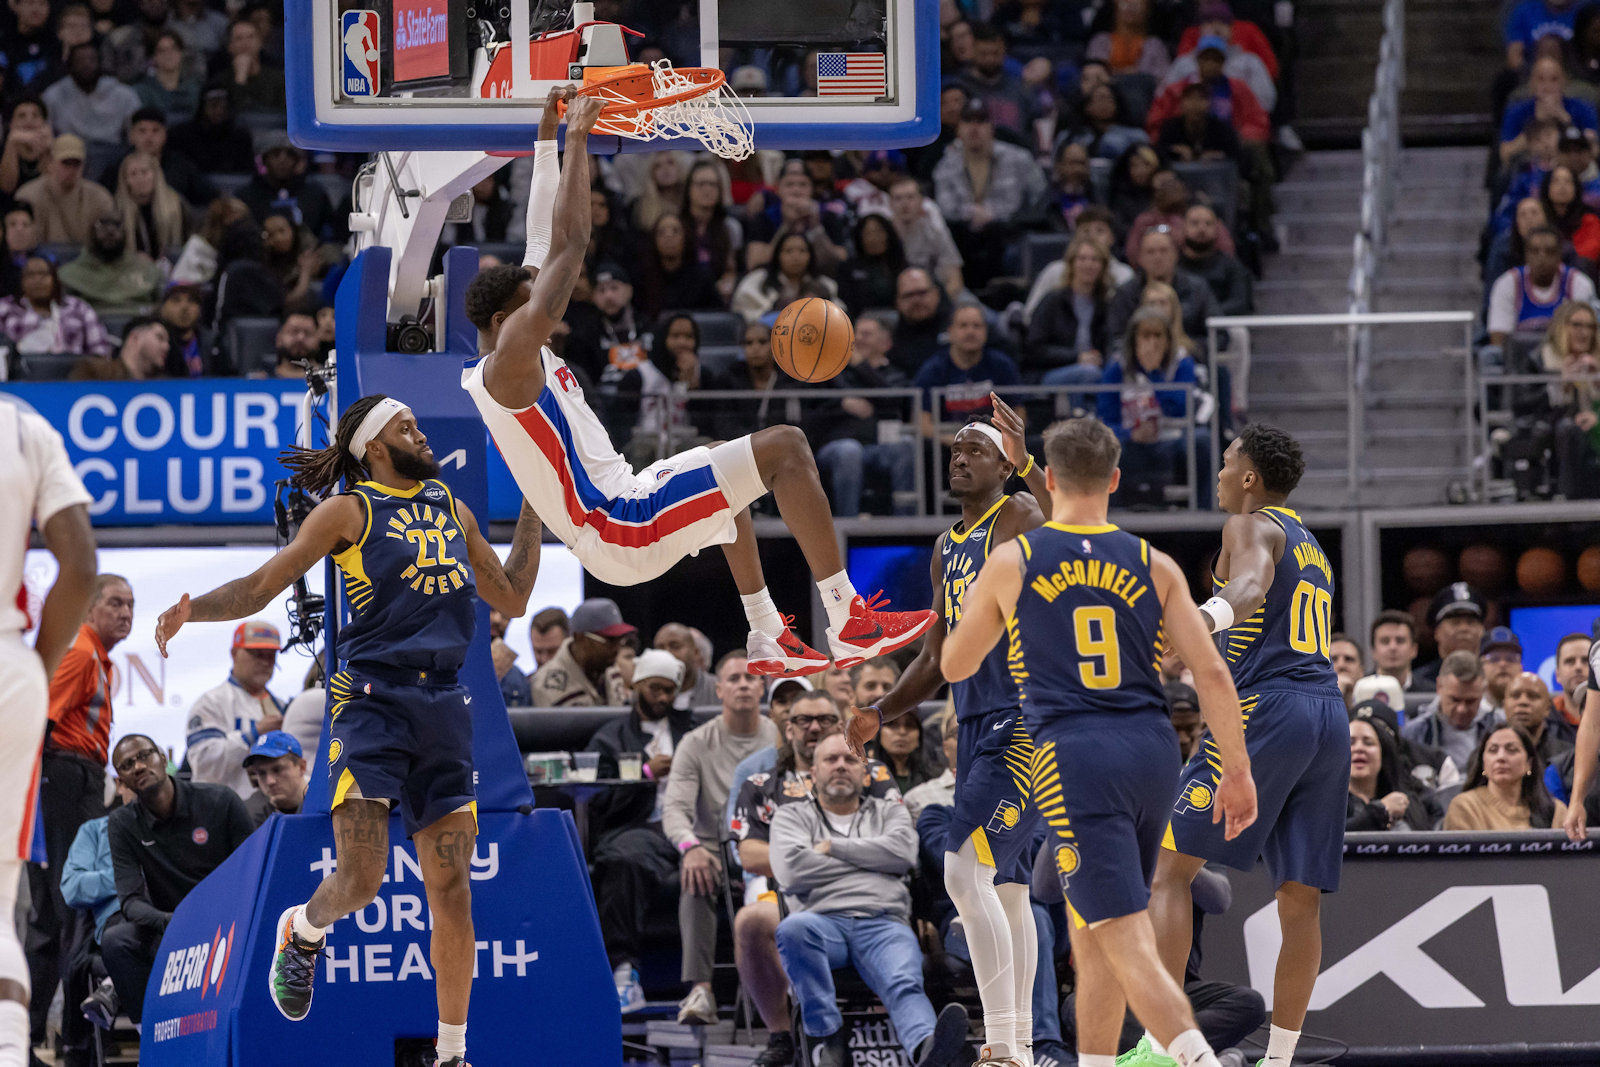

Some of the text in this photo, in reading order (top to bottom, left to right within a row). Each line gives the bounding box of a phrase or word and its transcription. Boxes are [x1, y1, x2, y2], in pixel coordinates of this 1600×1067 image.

[347, 78, 366, 92] NBA
[67, 392, 331, 451] COURT
[74, 456, 267, 515] CLUB
[386, 503, 458, 541] INDIANA
[405, 529, 458, 568] 22
[400, 562, 469, 595] PACERS
[1031, 559, 1148, 608] McCONNELL
[1289, 579, 1332, 664] 00
[1072, 605, 1122, 690] 9
[159, 942, 210, 997] BELFOR
[848, 1018, 900, 1048] ittl
